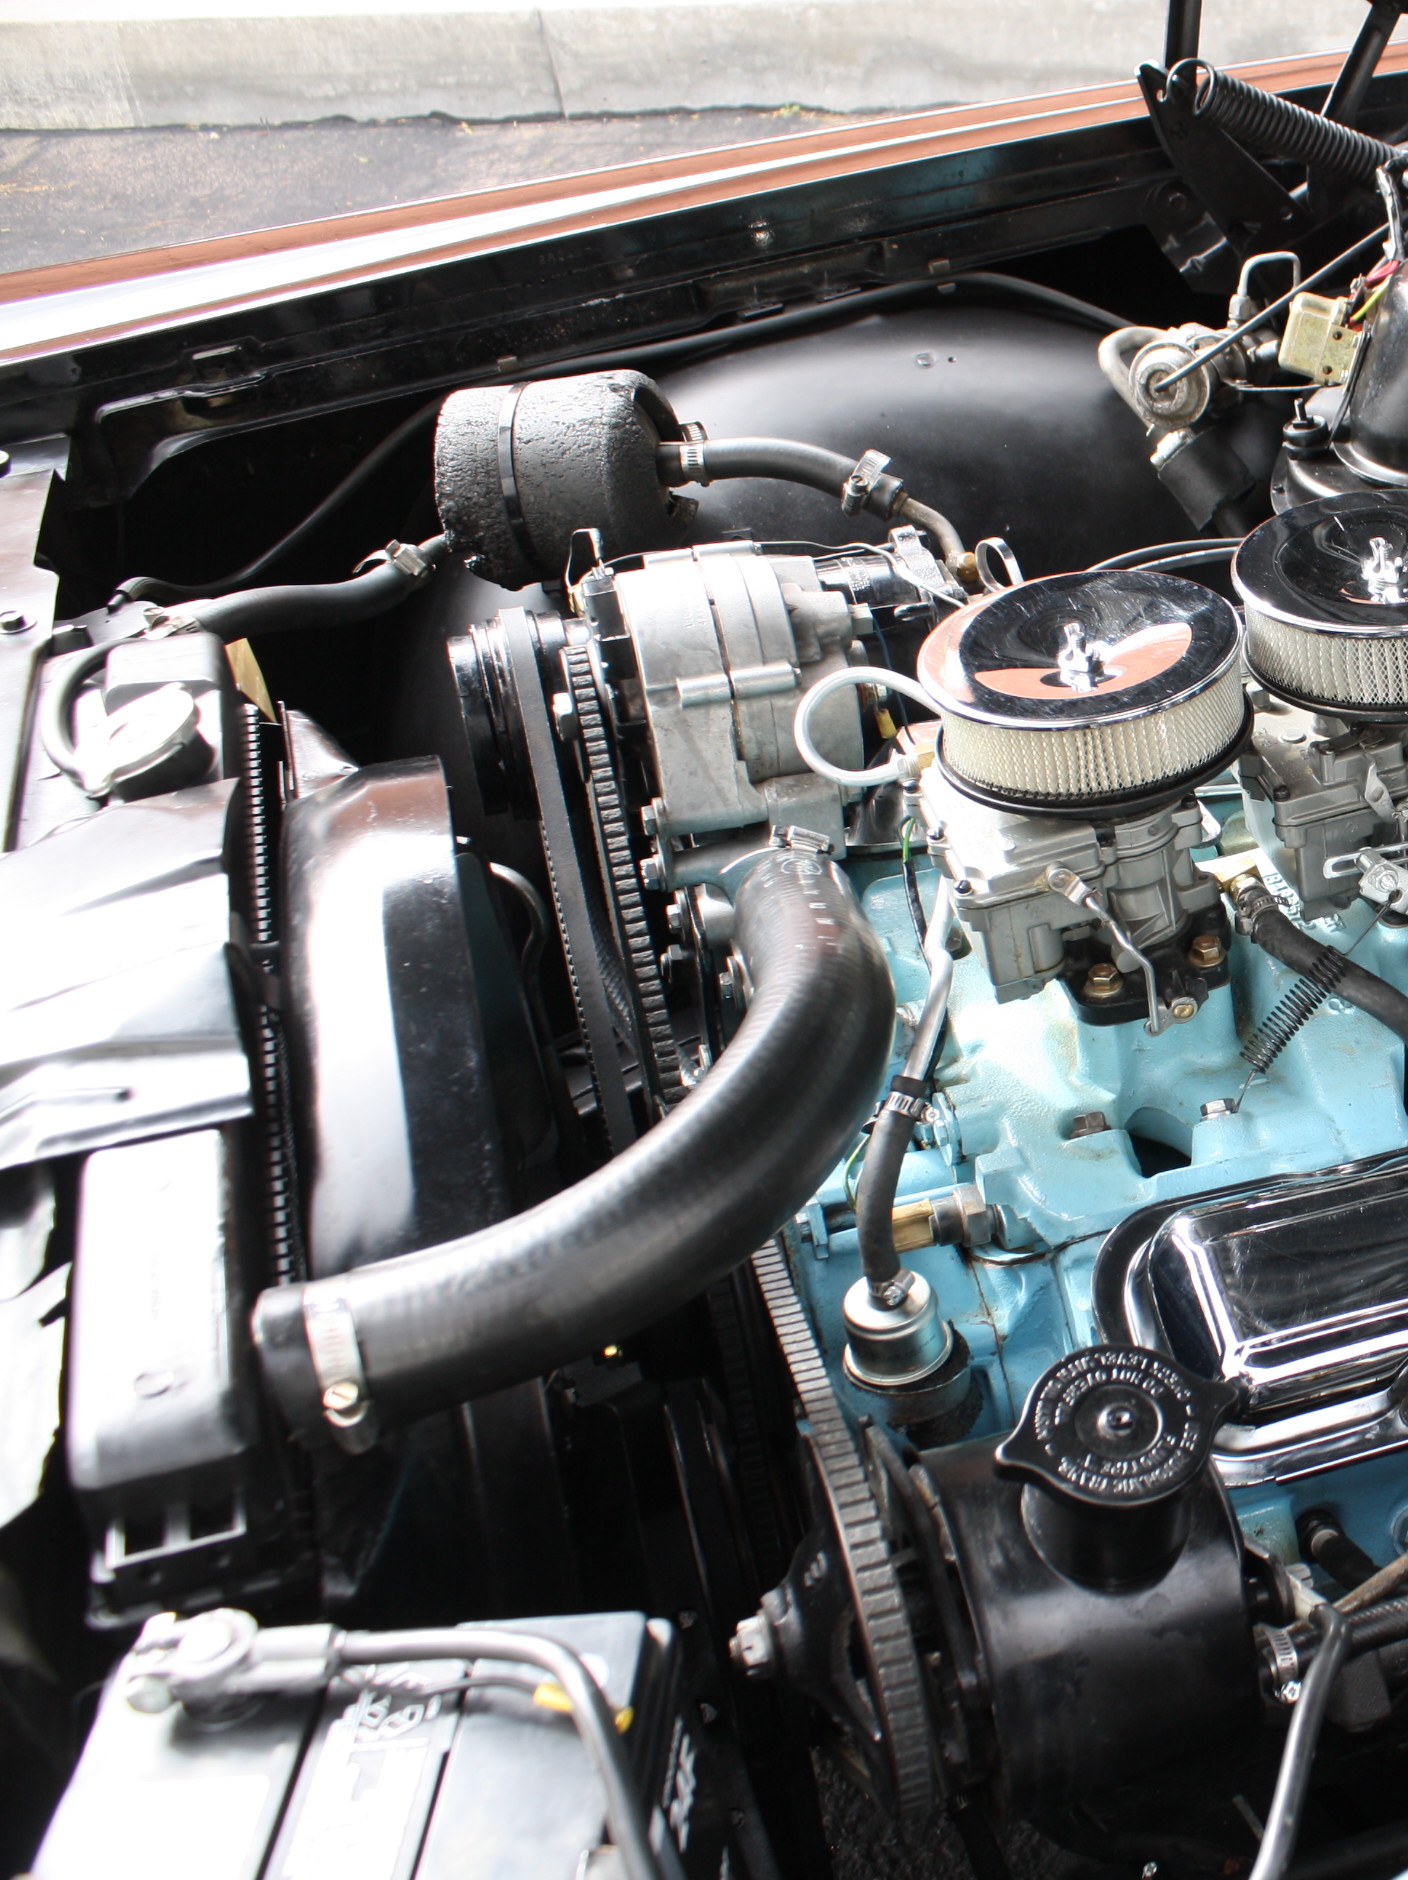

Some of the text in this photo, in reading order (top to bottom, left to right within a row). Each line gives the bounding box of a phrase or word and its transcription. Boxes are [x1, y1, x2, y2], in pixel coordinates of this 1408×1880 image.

[1094, 1351, 1148, 1369] LEVEL
[1110, 1367, 1143, 1386] NOT
[1142, 1376, 1165, 1399] DO
